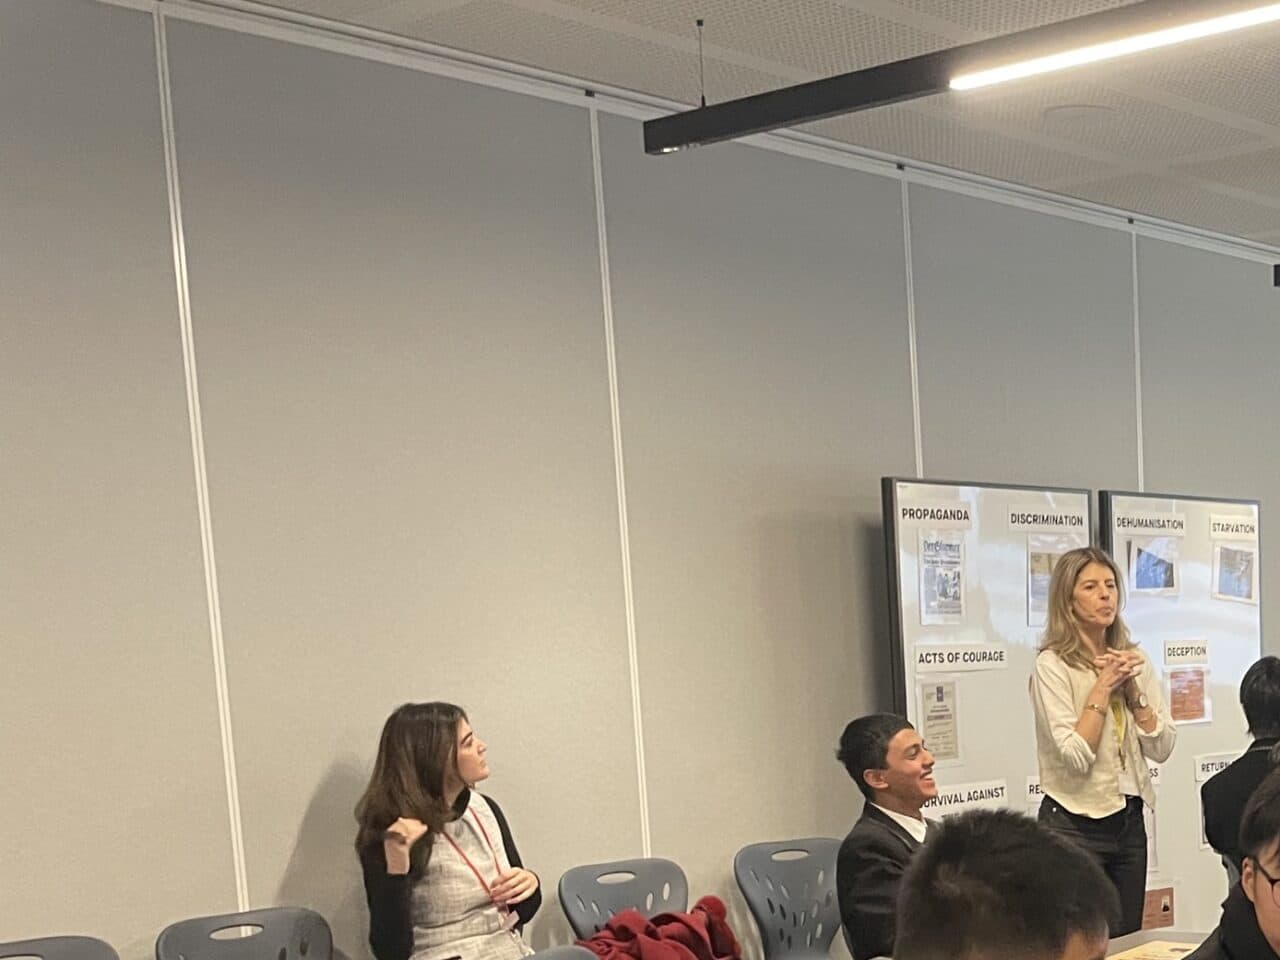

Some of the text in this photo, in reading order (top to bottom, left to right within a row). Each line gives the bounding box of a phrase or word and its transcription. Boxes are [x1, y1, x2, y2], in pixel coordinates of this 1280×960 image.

[902, 508, 970, 521] PROPAGANDA
[1010, 513, 1083, 527] DISCRIMINATION
[1117, 517, 1184, 530] DEHUMANISATION
[1212, 523, 1255, 534] STARVATION
[918, 650, 1005, 664] ACTS OF COURAGE
[1167, 646, 1206, 657] DECEPTION
[921, 786, 1005, 809] URVIVAL AGAINST
